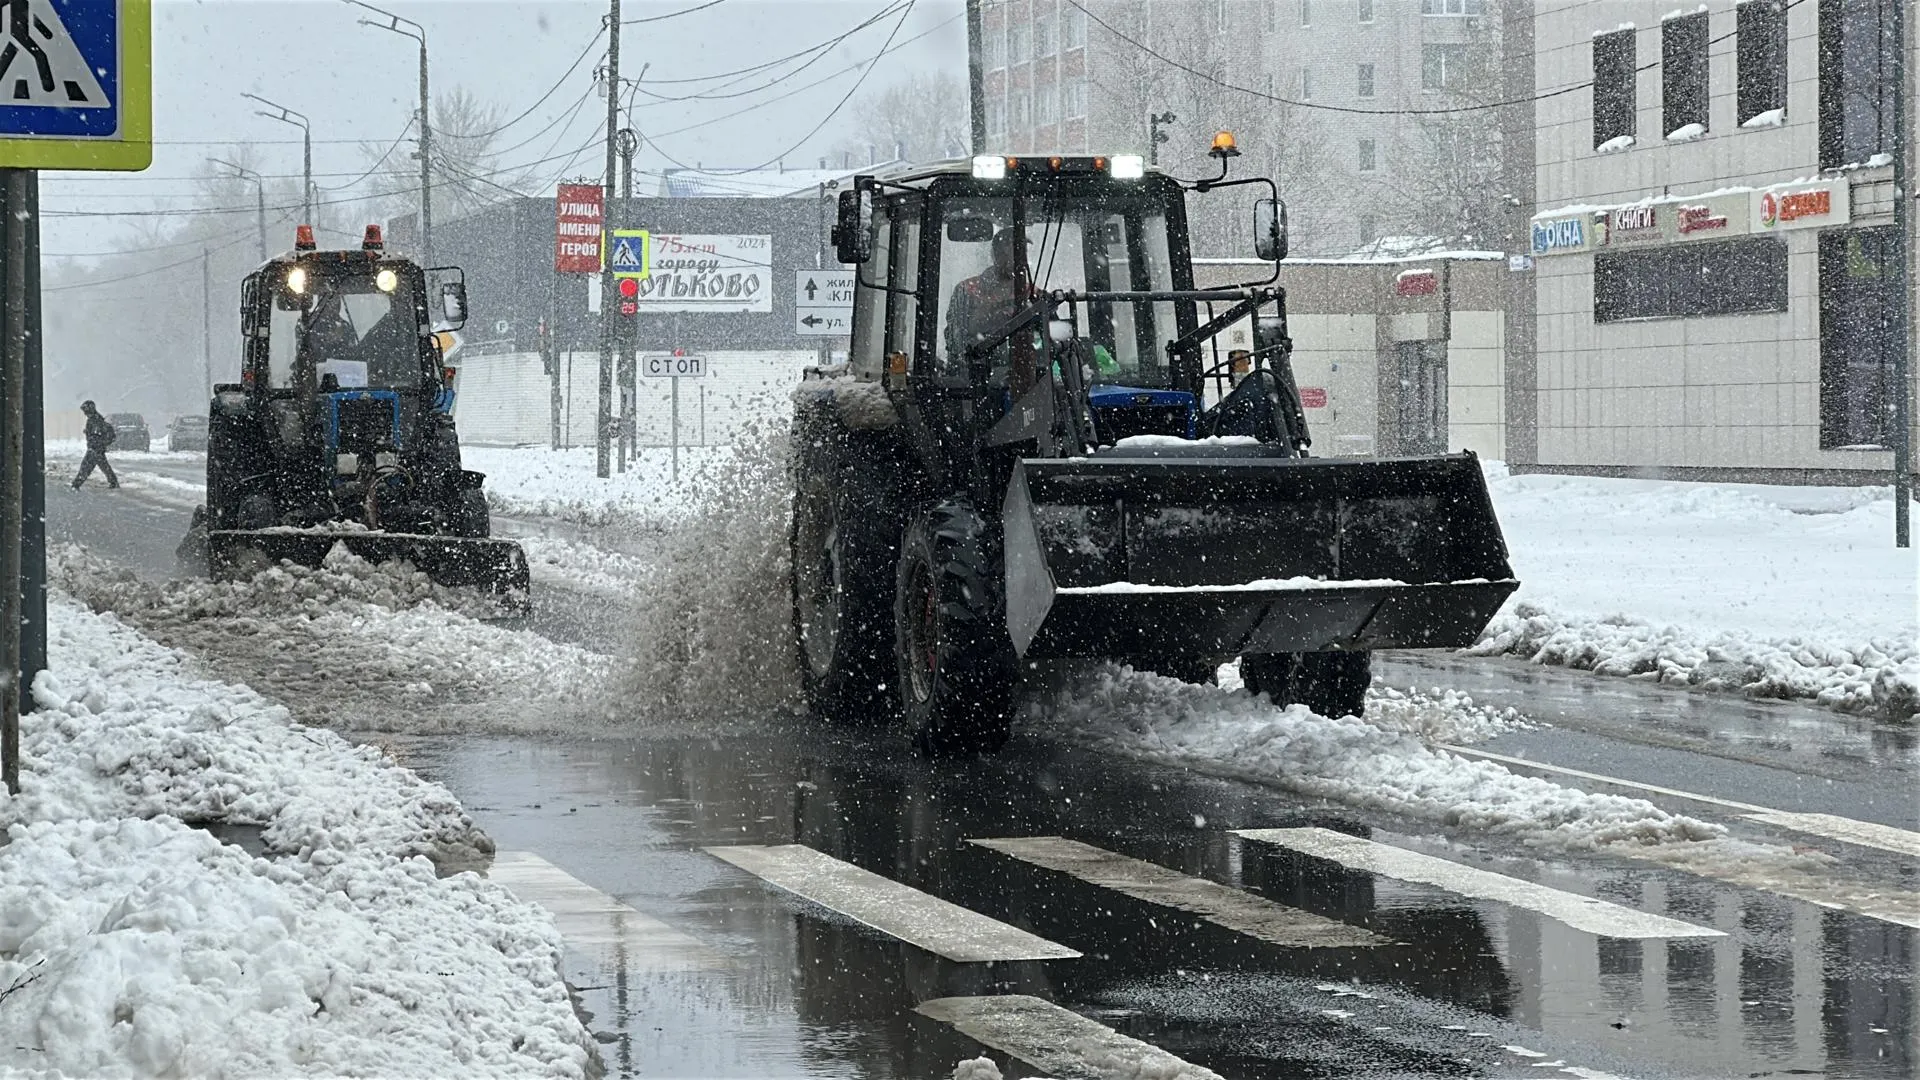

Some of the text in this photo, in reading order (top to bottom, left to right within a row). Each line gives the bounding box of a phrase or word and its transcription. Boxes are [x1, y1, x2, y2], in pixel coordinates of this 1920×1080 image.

[560, 202, 600, 218] УЛИЦА
[1615, 206, 1653, 231] КНИГИ
[559, 222, 600, 236] ИМЕНИ
[1546, 219, 1581, 247] ОКНА
[561, 242, 597, 256] ГЕРОЯ
[736, 237, 767, 249] 2024
[656, 259, 720, 274] городу
[639, 273, 760, 298] ОТЬКОВО
[826, 279, 854, 288] жил
[826, 290, 852, 302] «КЛ
[826, 318, 844, 330] ул.
[650, 359, 700, 374] СТОП
